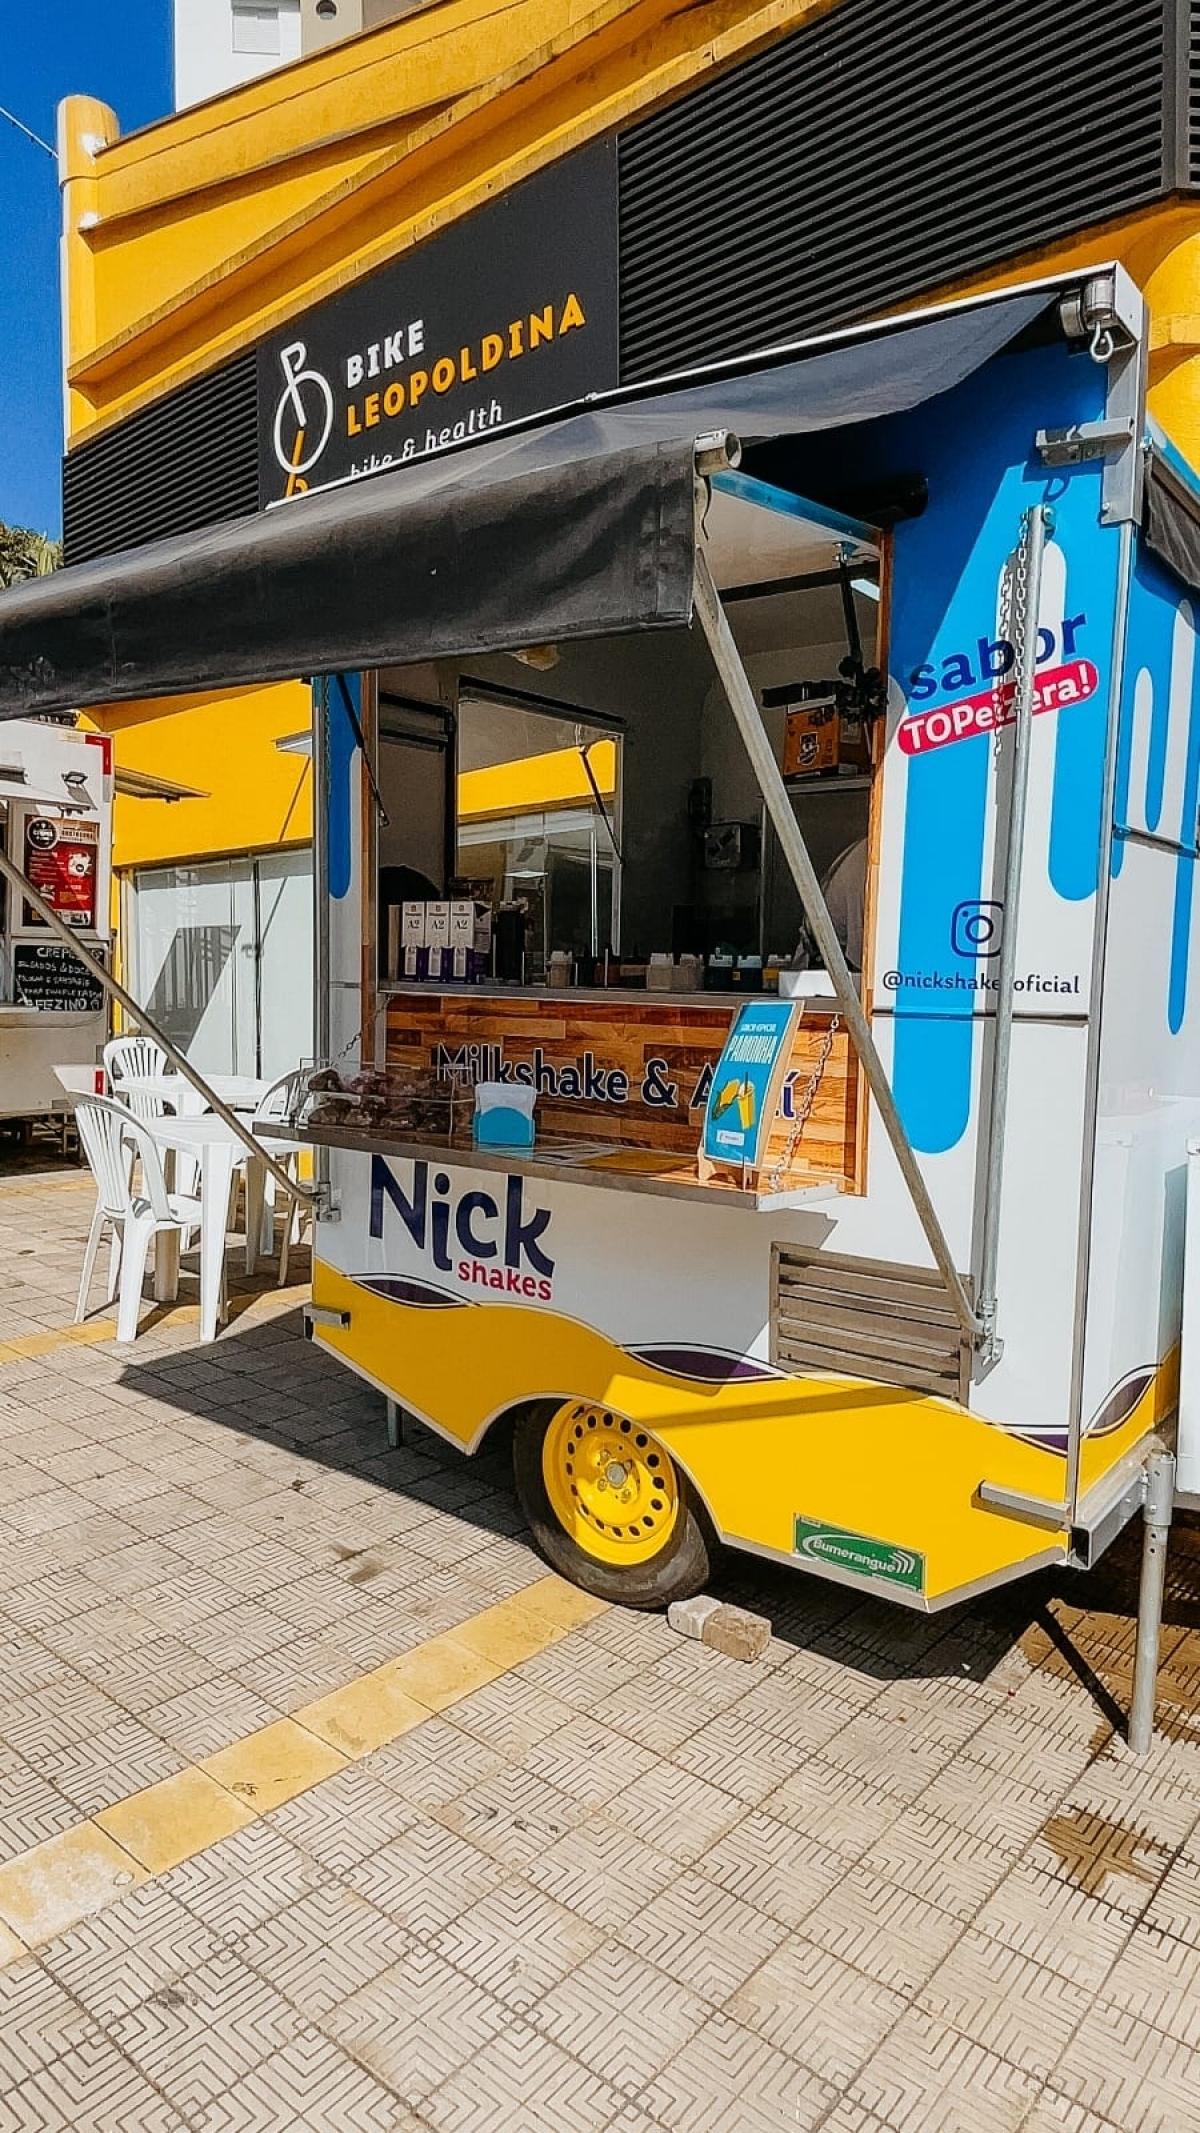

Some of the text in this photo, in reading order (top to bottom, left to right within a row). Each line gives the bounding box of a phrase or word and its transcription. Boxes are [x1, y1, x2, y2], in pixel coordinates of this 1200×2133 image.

[346, 319, 425, 389] BIKE
[346, 293, 586, 437] LEOPOLDINA
[402, 438, 416, 458] &
[425, 399, 503, 450] health
[909, 613, 1087, 701] sabor
[435, 1042, 629, 1102] Milkshake
[641, 1055, 679, 1108] &
[369, 1153, 556, 1279] Nick
[458, 1260, 552, 1301] shakes
[812, 1539, 896, 1573] Bumerangue
